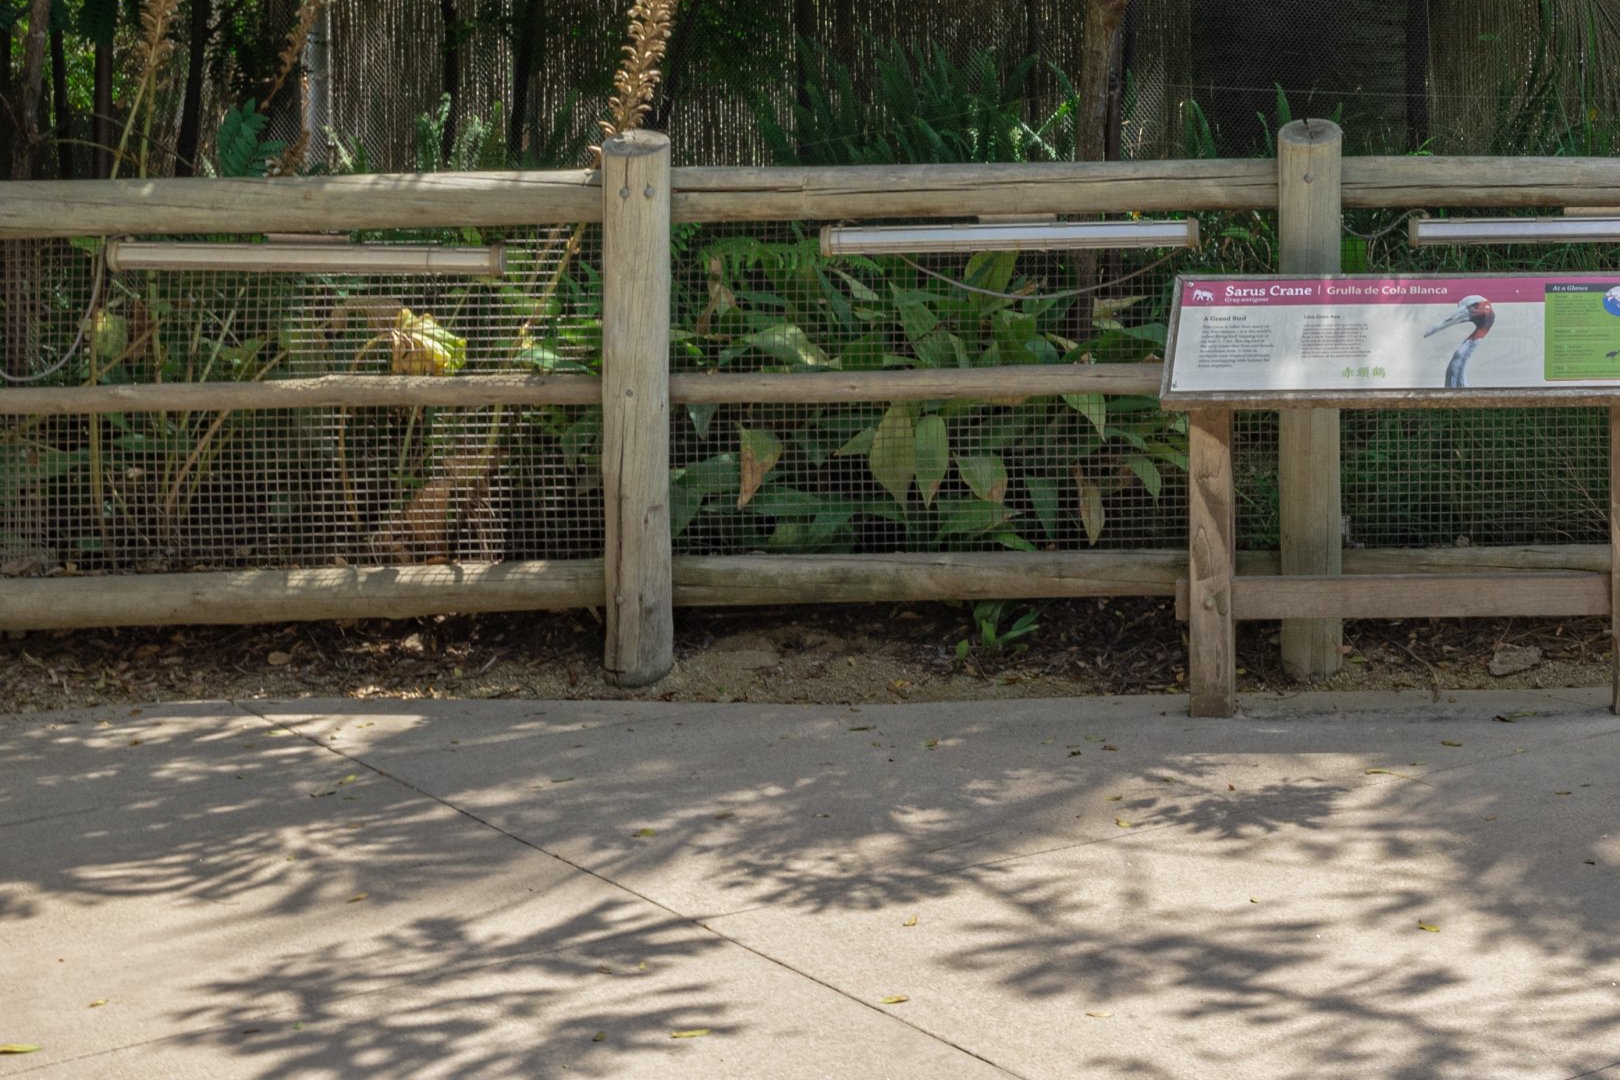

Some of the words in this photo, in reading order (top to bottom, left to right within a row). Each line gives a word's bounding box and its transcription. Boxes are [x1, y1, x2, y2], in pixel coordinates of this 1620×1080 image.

[1225, 285, 1266, 297] Sarus
[1269, 284, 1313, 296] Crane
[1327, 285, 1362, 295] Grulla
[1364, 285, 1379, 295] de
[1381, 285, 1407, 295] Cola
[1410, 285, 1448, 295] Blanca
